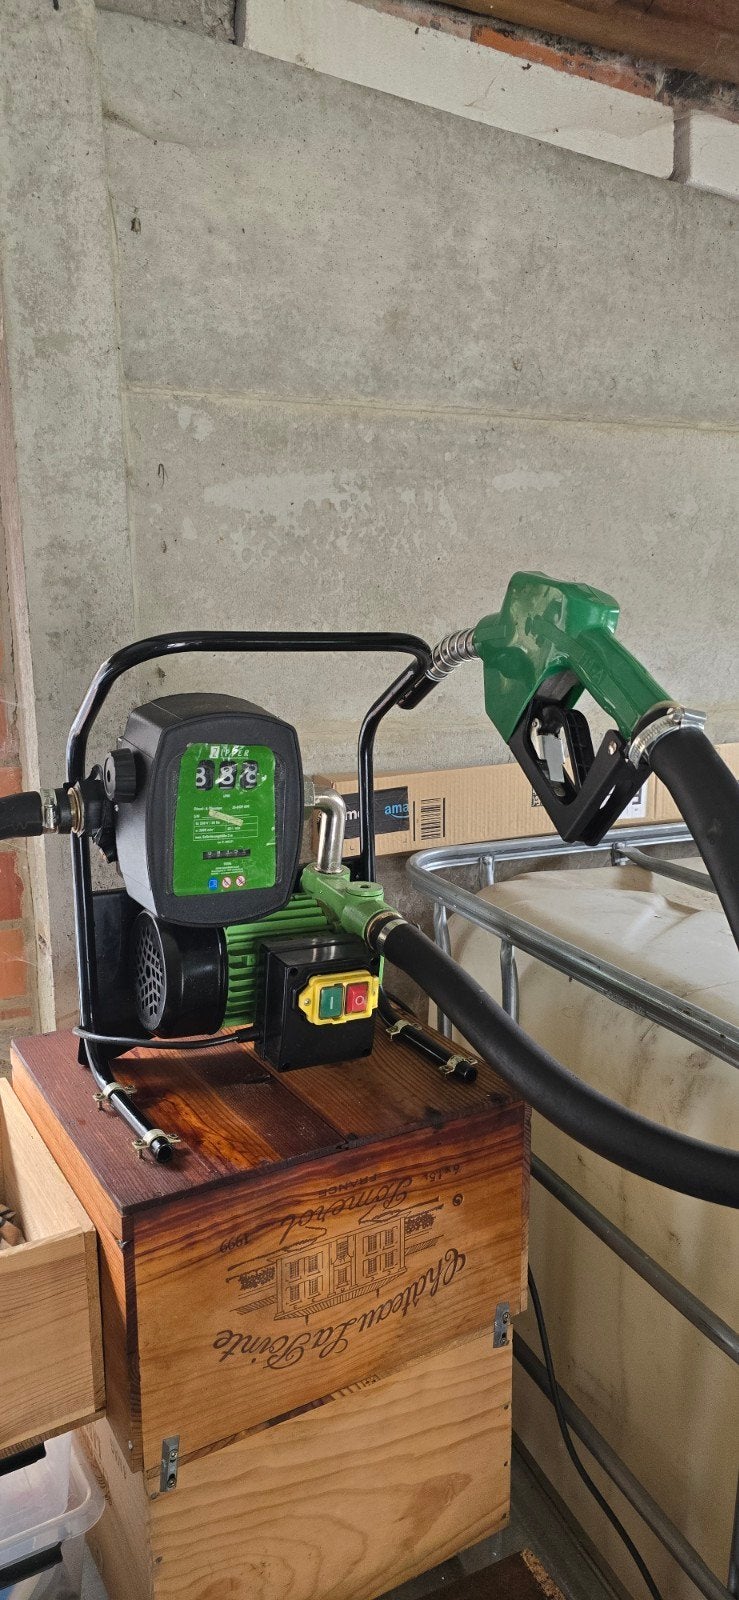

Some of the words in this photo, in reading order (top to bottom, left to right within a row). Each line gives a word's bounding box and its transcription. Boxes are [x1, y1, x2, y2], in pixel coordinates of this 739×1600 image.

[316, 1174, 378, 1198] FRANCE
[278, 1177, 412, 1246] Pomerol
[219, 1232, 252, 1254] 1999
[358, 1247, 467, 1333] Château
[212, 1329, 310, 1371] Pointe
[313, 1318, 358, 1359] La
